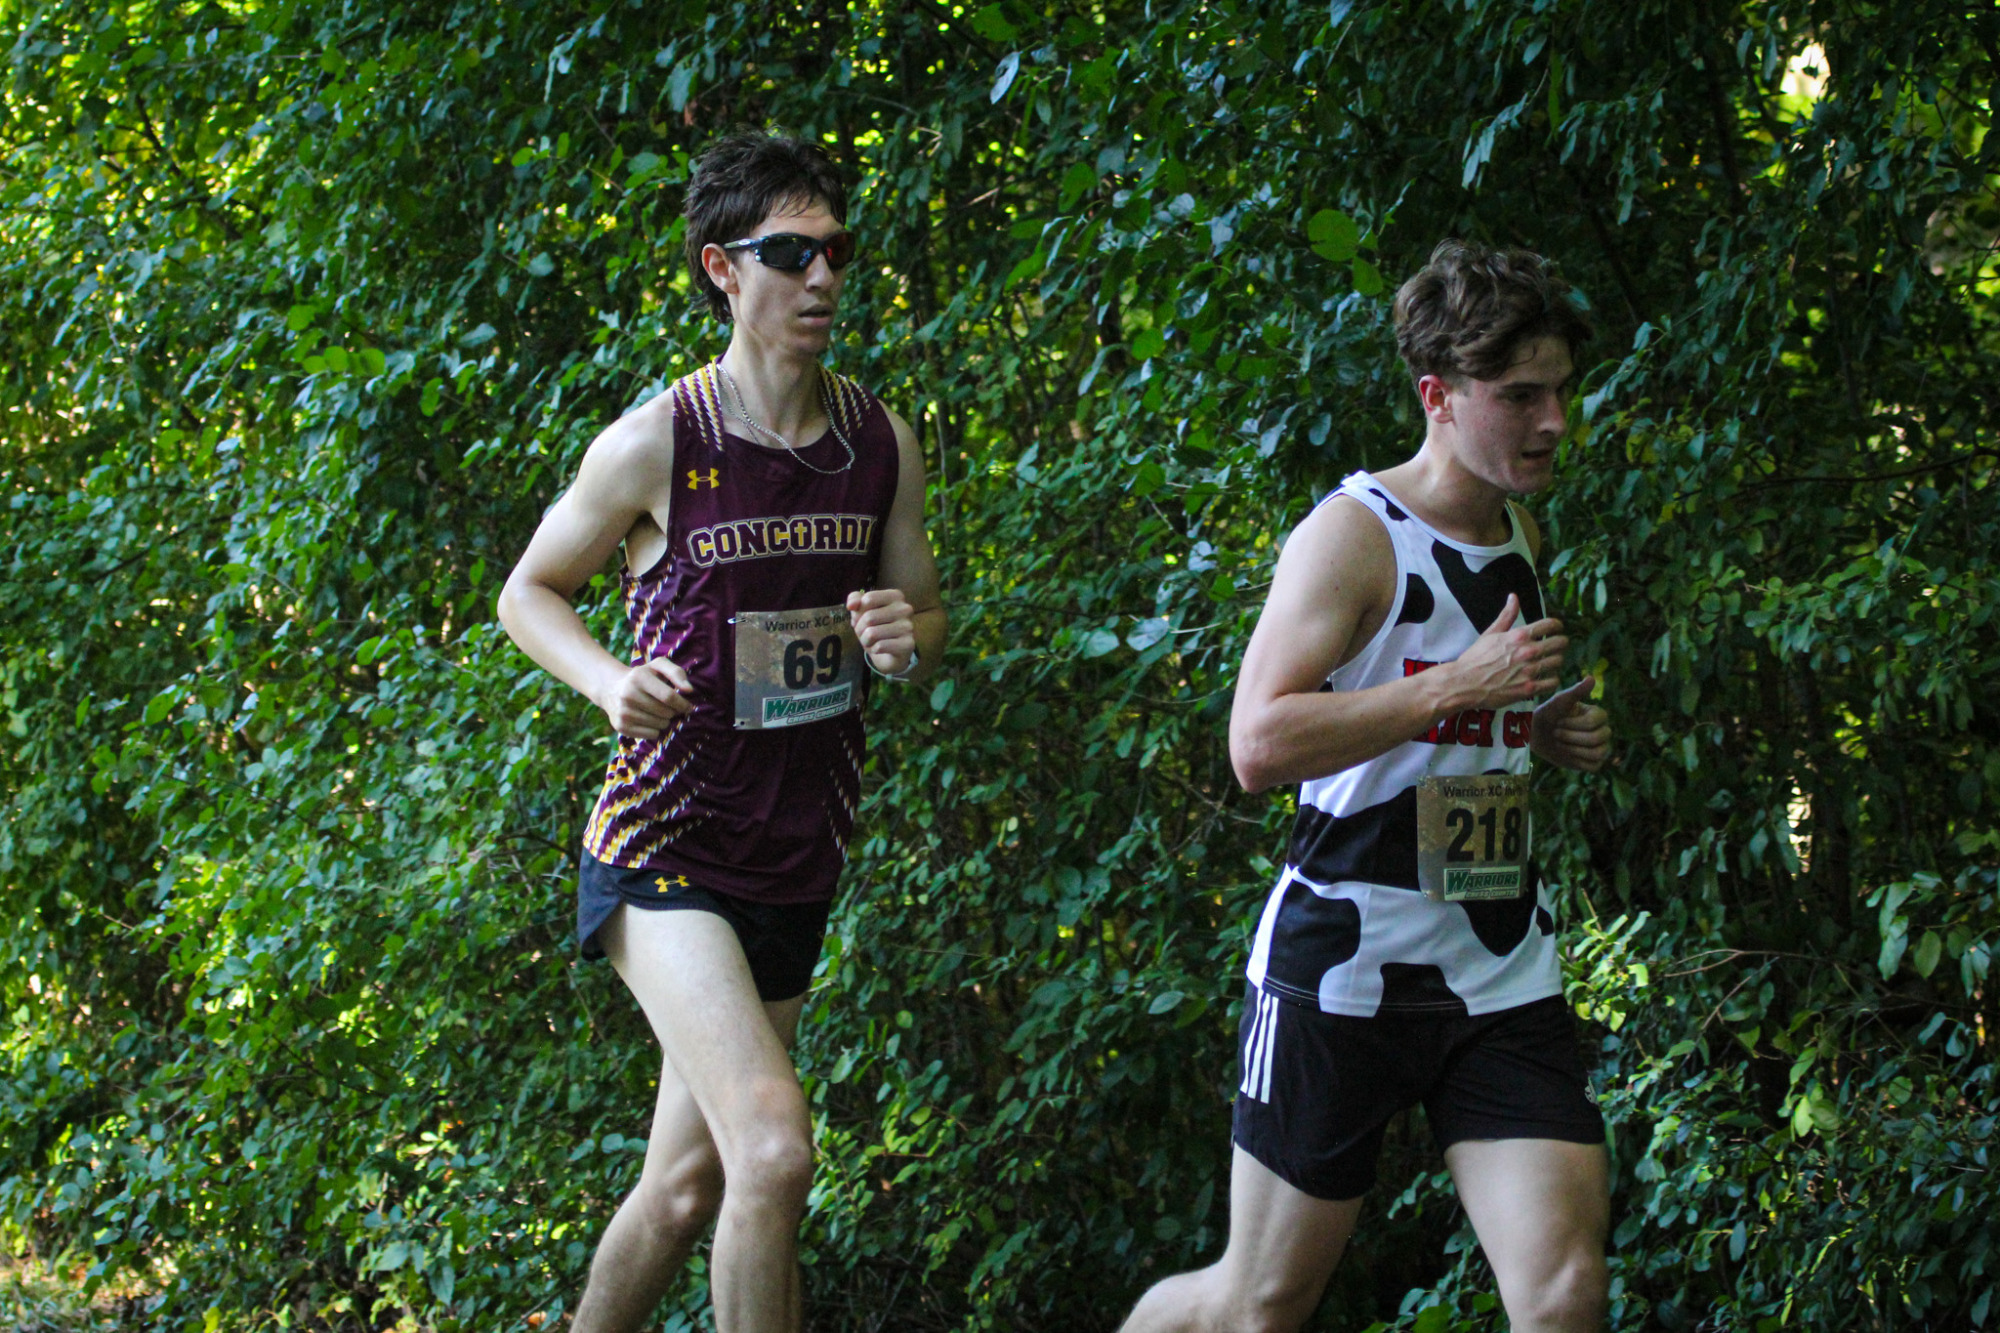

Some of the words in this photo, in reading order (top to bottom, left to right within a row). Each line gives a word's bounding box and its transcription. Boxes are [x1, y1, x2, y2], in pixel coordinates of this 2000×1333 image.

[687, 513, 876, 569] CONCORDI
[765, 618, 811, 632] Warrior
[814, 615, 830, 628] XC
[783, 634, 842, 690] 69
[1443, 786, 1485, 798] Warrior
[1487, 785, 1503, 797] XC
[1445, 807, 1521, 862] 218
